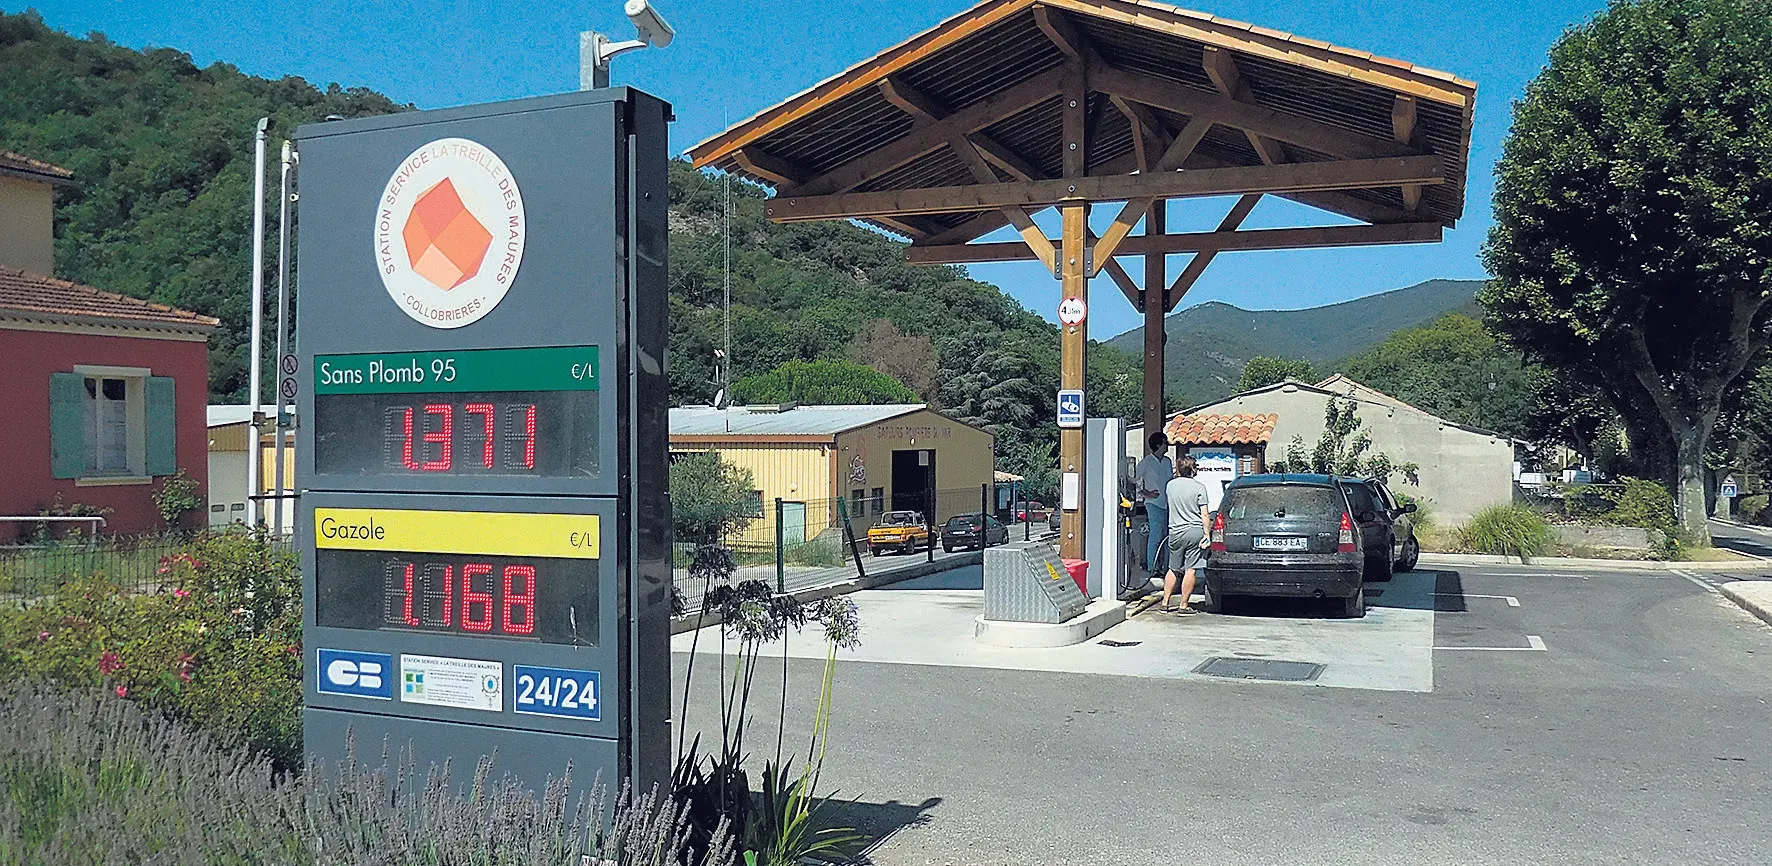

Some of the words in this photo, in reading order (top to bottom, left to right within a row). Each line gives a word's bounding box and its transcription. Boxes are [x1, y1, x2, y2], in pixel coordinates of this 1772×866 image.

[432, 145, 448, 158] LA
[452, 144, 502, 179] TREILLE
[386, 151, 429, 205] SERVICE
[498, 178, 517, 211] DES
[380, 209, 396, 275] STATION
[496, 215, 519, 285] MAURES
[406, 295, 481, 321] COLLOBRIERES
[321, 362, 363, 385] Sans
[369, 358, 425, 383] Plomb
[431, 358, 456, 382] 95
[571, 363, 594, 380] €/L
[403, 403, 536, 471] 1.371
[321, 517, 385, 541] Gazole
[570, 532, 593, 548] €/L
[403, 562, 536, 634] 1.168
[327, 659, 382, 689] CB
[518, 675, 597, 711] 24/24
